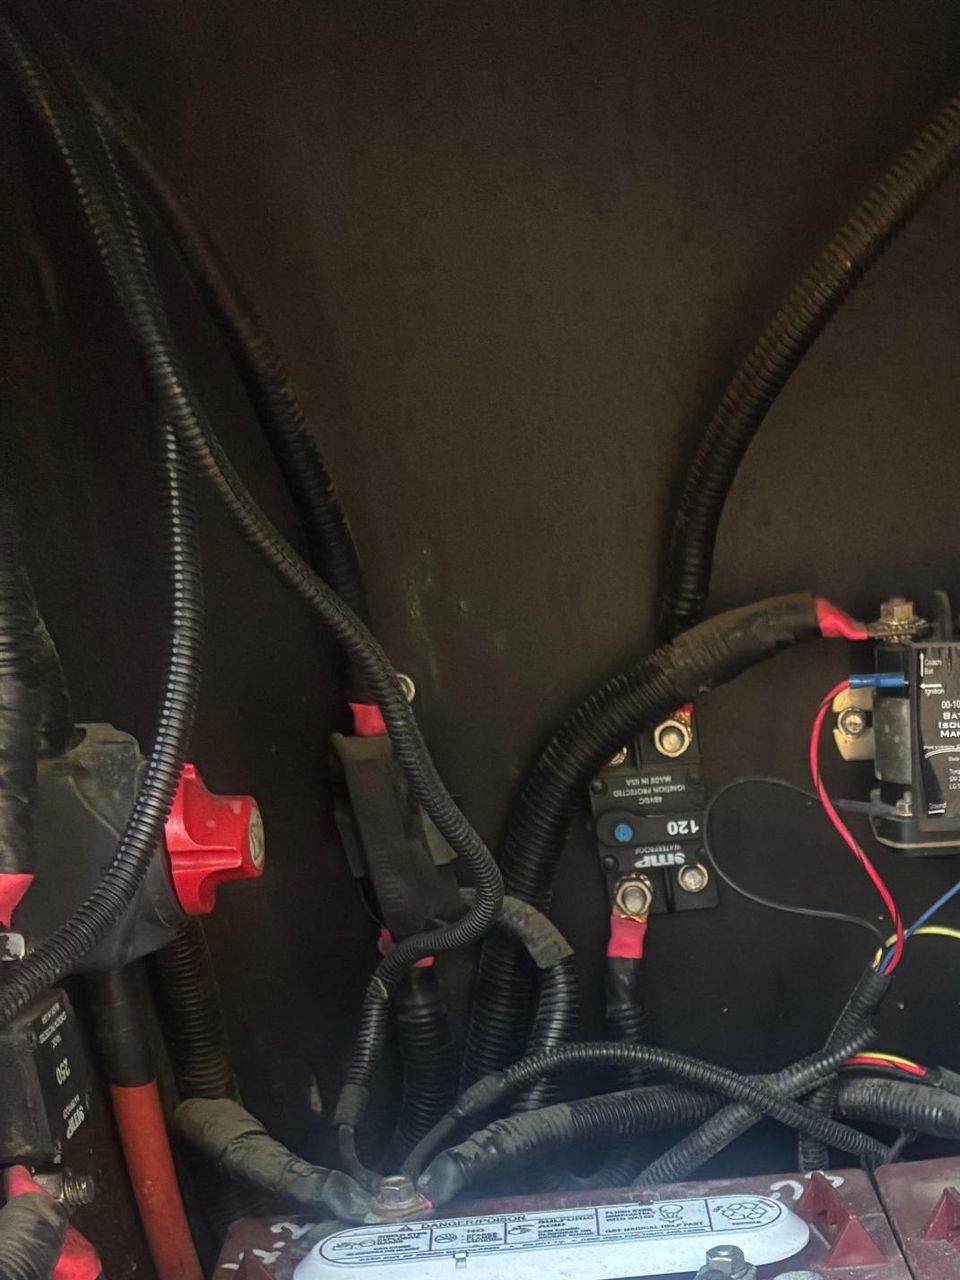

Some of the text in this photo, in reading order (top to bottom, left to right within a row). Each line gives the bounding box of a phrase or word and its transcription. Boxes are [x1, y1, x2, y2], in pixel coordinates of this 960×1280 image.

[612, 784, 686, 798] IGNITION PROTECTED
[666, 819, 700, 836] 120
[634, 844, 682, 855] WATERPROOF
[55, 1056, 71, 1086] 250
[421, 1215, 527, 1230] DANGER/POISON
